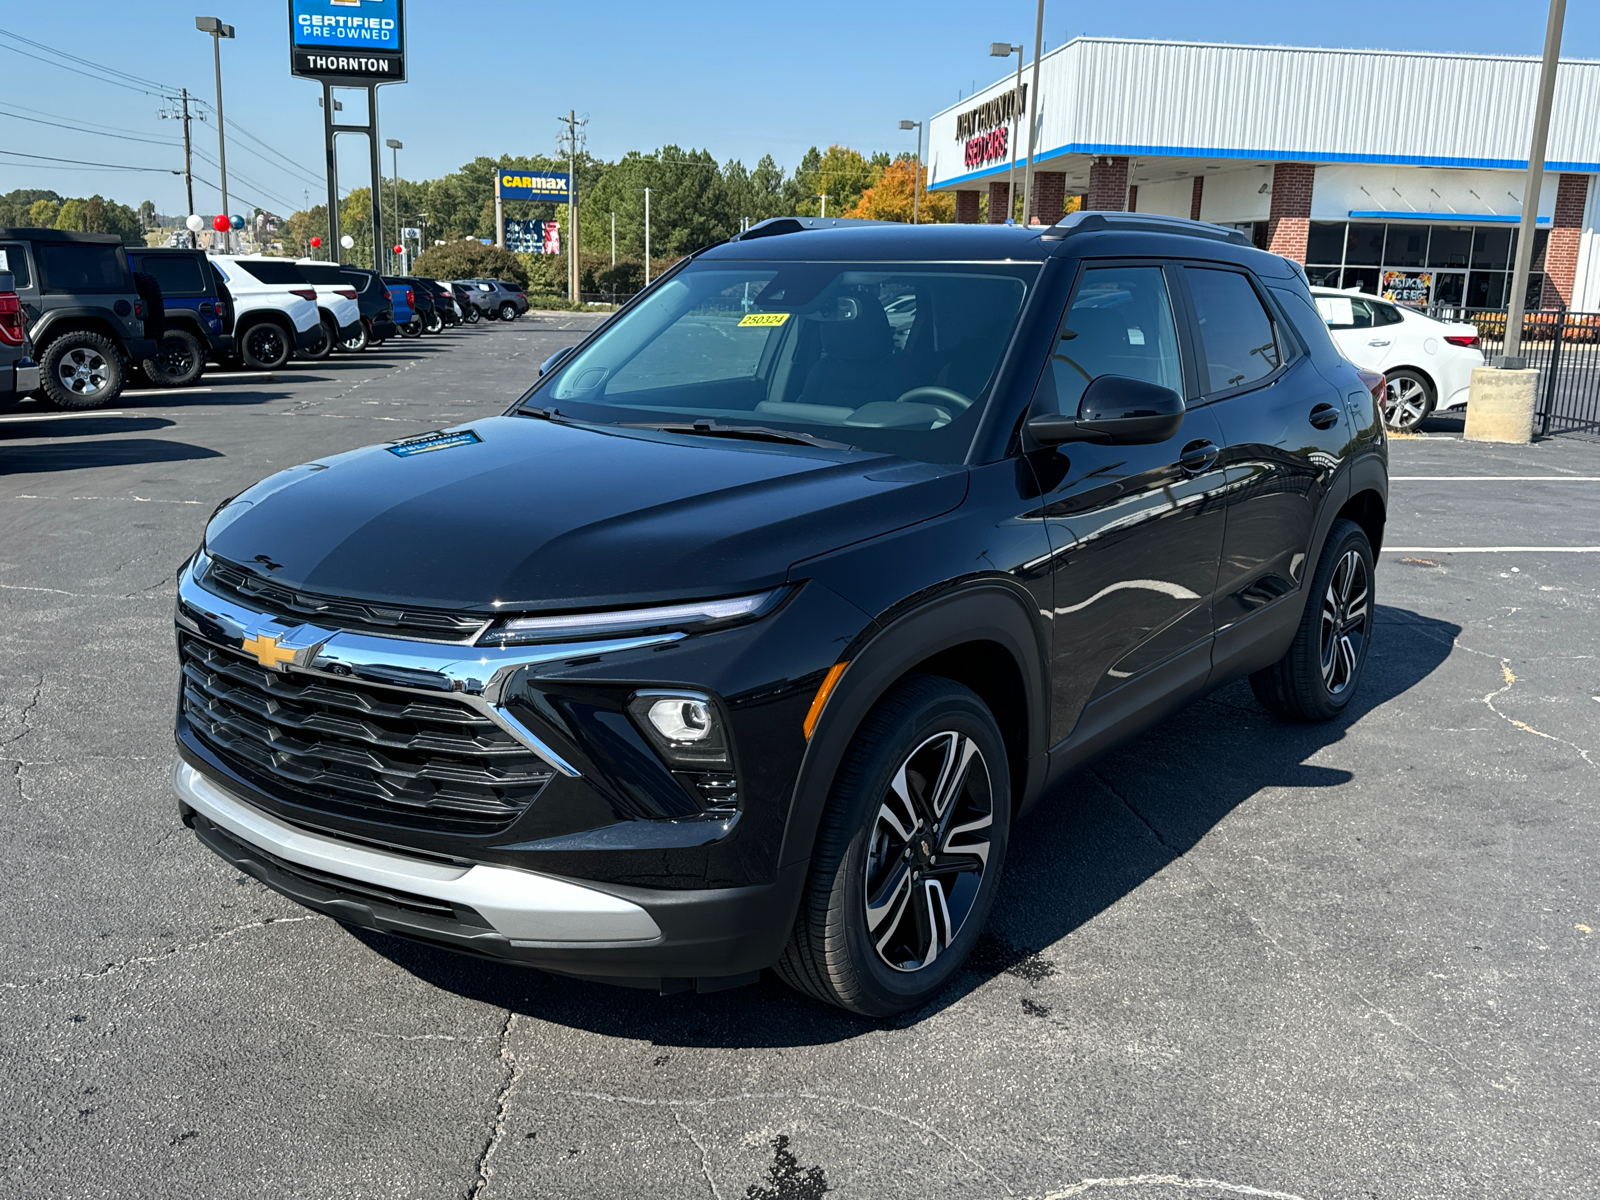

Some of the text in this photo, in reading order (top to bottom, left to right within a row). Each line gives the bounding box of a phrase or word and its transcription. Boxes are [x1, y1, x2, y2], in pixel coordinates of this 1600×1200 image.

[298, 14, 395, 30] CERTIFIED
[303, 27, 390, 41] PRE-OWNED
[307, 55, 389, 72] THORNTON
[955, 83, 1028, 141] JOHN THORNTON
[964, 127, 1008, 167] USED CARS
[742, 314, 784, 325] 250324
